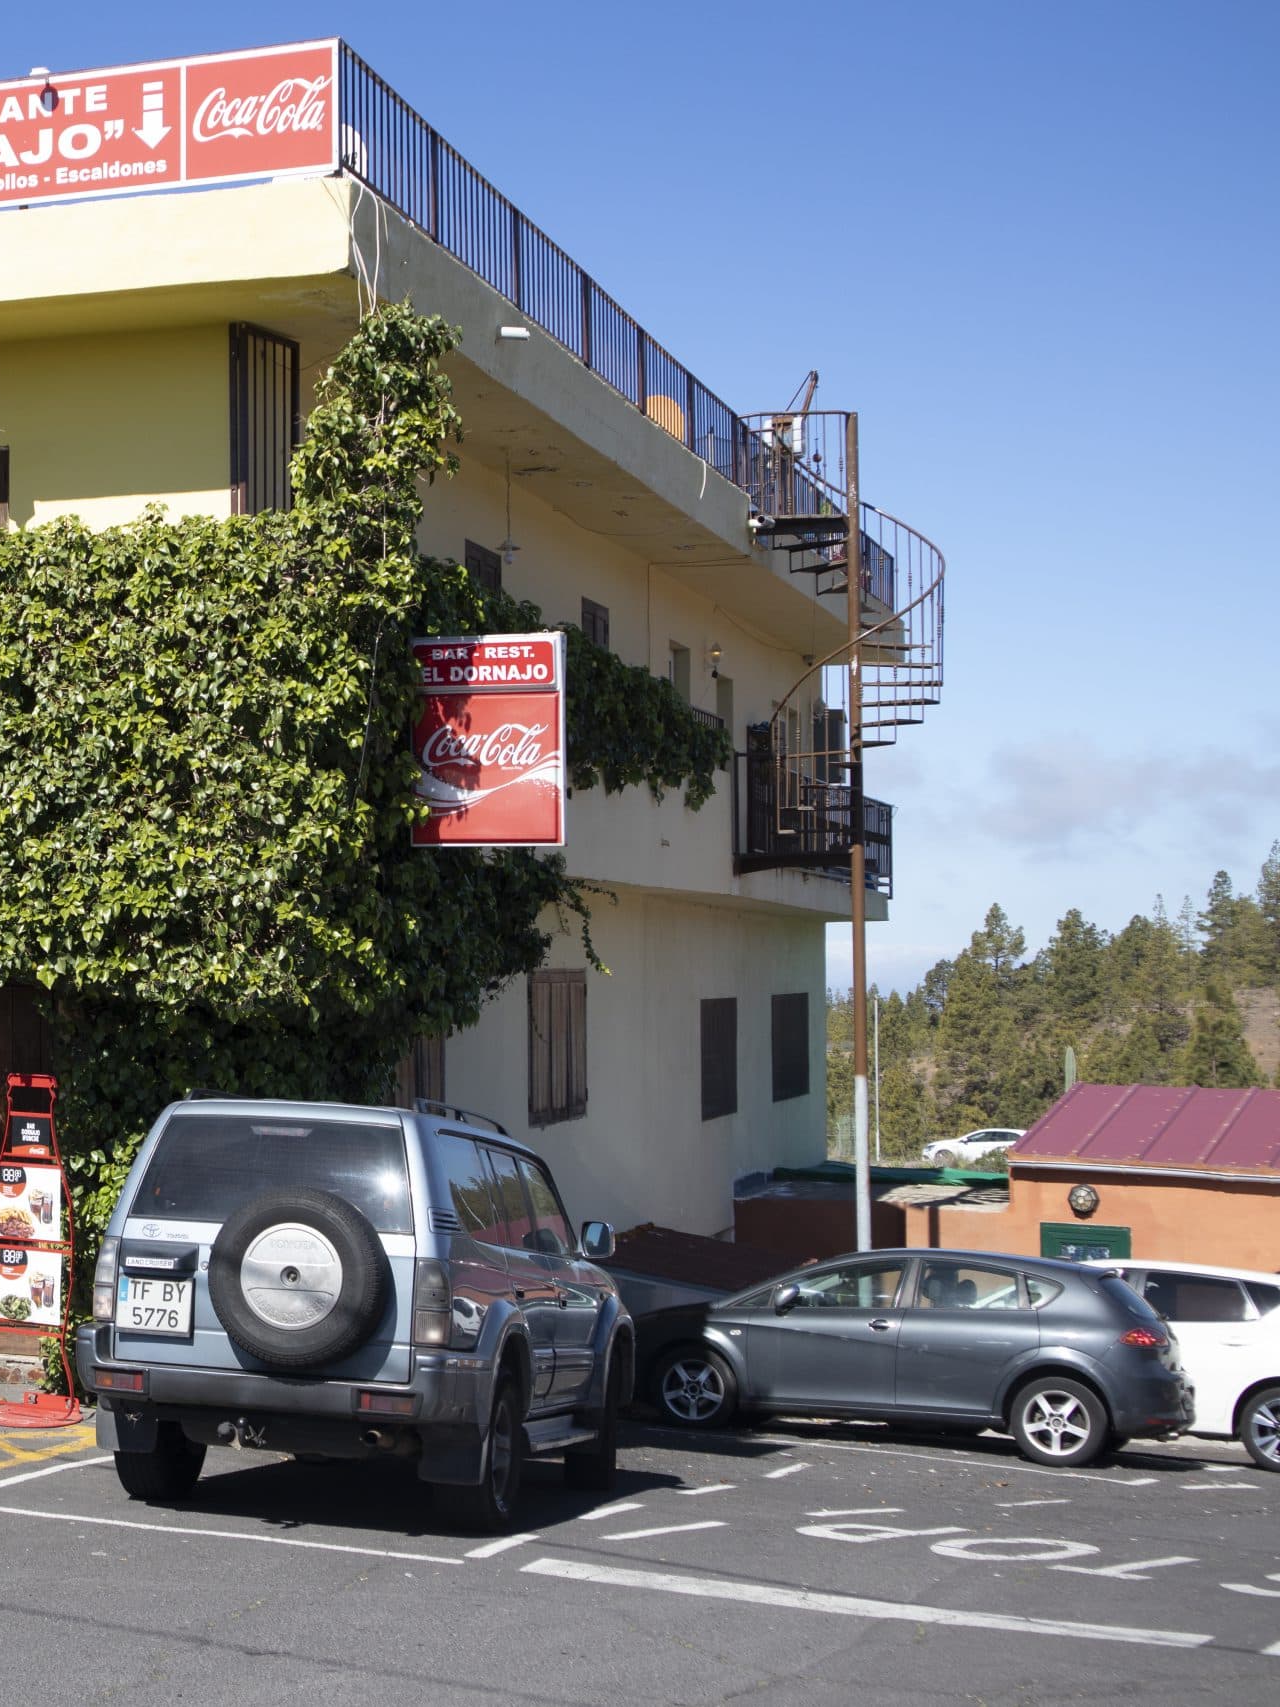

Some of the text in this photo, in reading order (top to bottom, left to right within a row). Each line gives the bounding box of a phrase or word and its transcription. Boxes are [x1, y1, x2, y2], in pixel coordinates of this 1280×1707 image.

[192, 74, 332, 143] Coca-Cola
[56, 159, 167, 185] Escaldones
[432, 648, 469, 660] BAR
[484, 646, 535, 659] REST.
[422, 664, 548, 682] EL DORNAJO
[422, 723, 549, 767] Coca-Cola
[145, 1259, 173, 1267] CRUISER
[131, 1280, 186, 1304] TF BY
[132, 1306, 179, 1329] 5776
